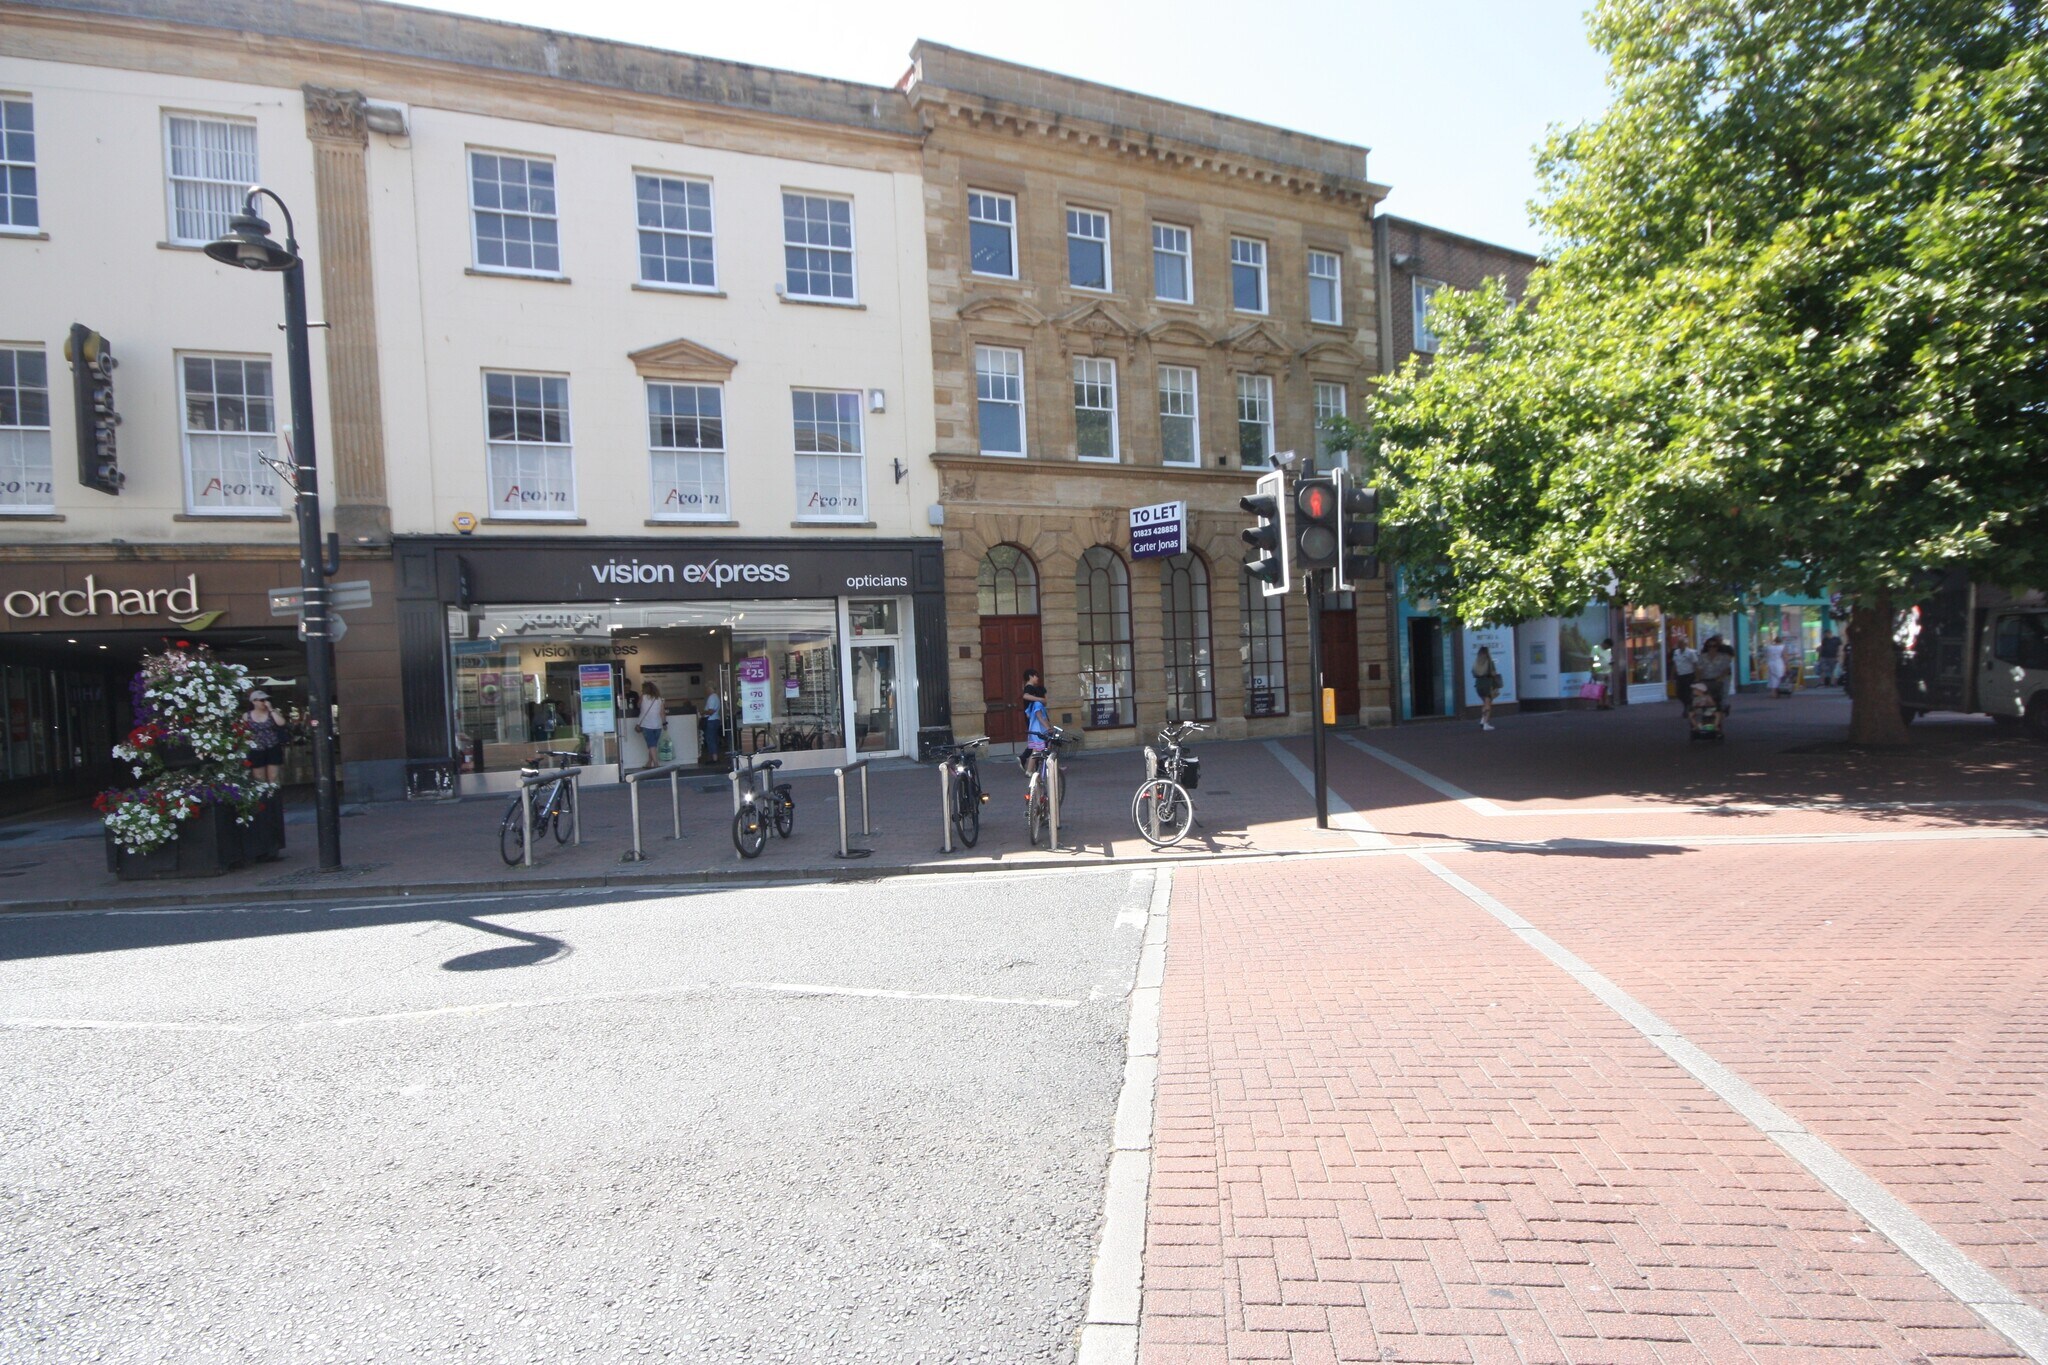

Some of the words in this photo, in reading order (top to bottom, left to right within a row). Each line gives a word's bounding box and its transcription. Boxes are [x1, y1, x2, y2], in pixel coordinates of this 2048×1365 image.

[200, 478, 275, 496] Acorn
[504, 485, 566, 502] Acorn
[664, 488, 720, 504] Acorn
[808, 491, 857, 507] Acorn
[1133, 509, 1150, 523] TO
[1153, 504, 1177, 520] LET
[1133, 528, 1152, 538] 01823
[1153, 524, 1178, 535] 428858
[1133, 542, 1157, 552] Carter
[1158, 539, 1179, 552] Jonas
[591, 558, 675, 583] vision
[682, 558, 790, 588] express
[846, 574, 908, 590] opticians
[4, 573, 199, 617] orchard
[533, 644, 576, 658] vision
[746, 669, 764, 678] £25
